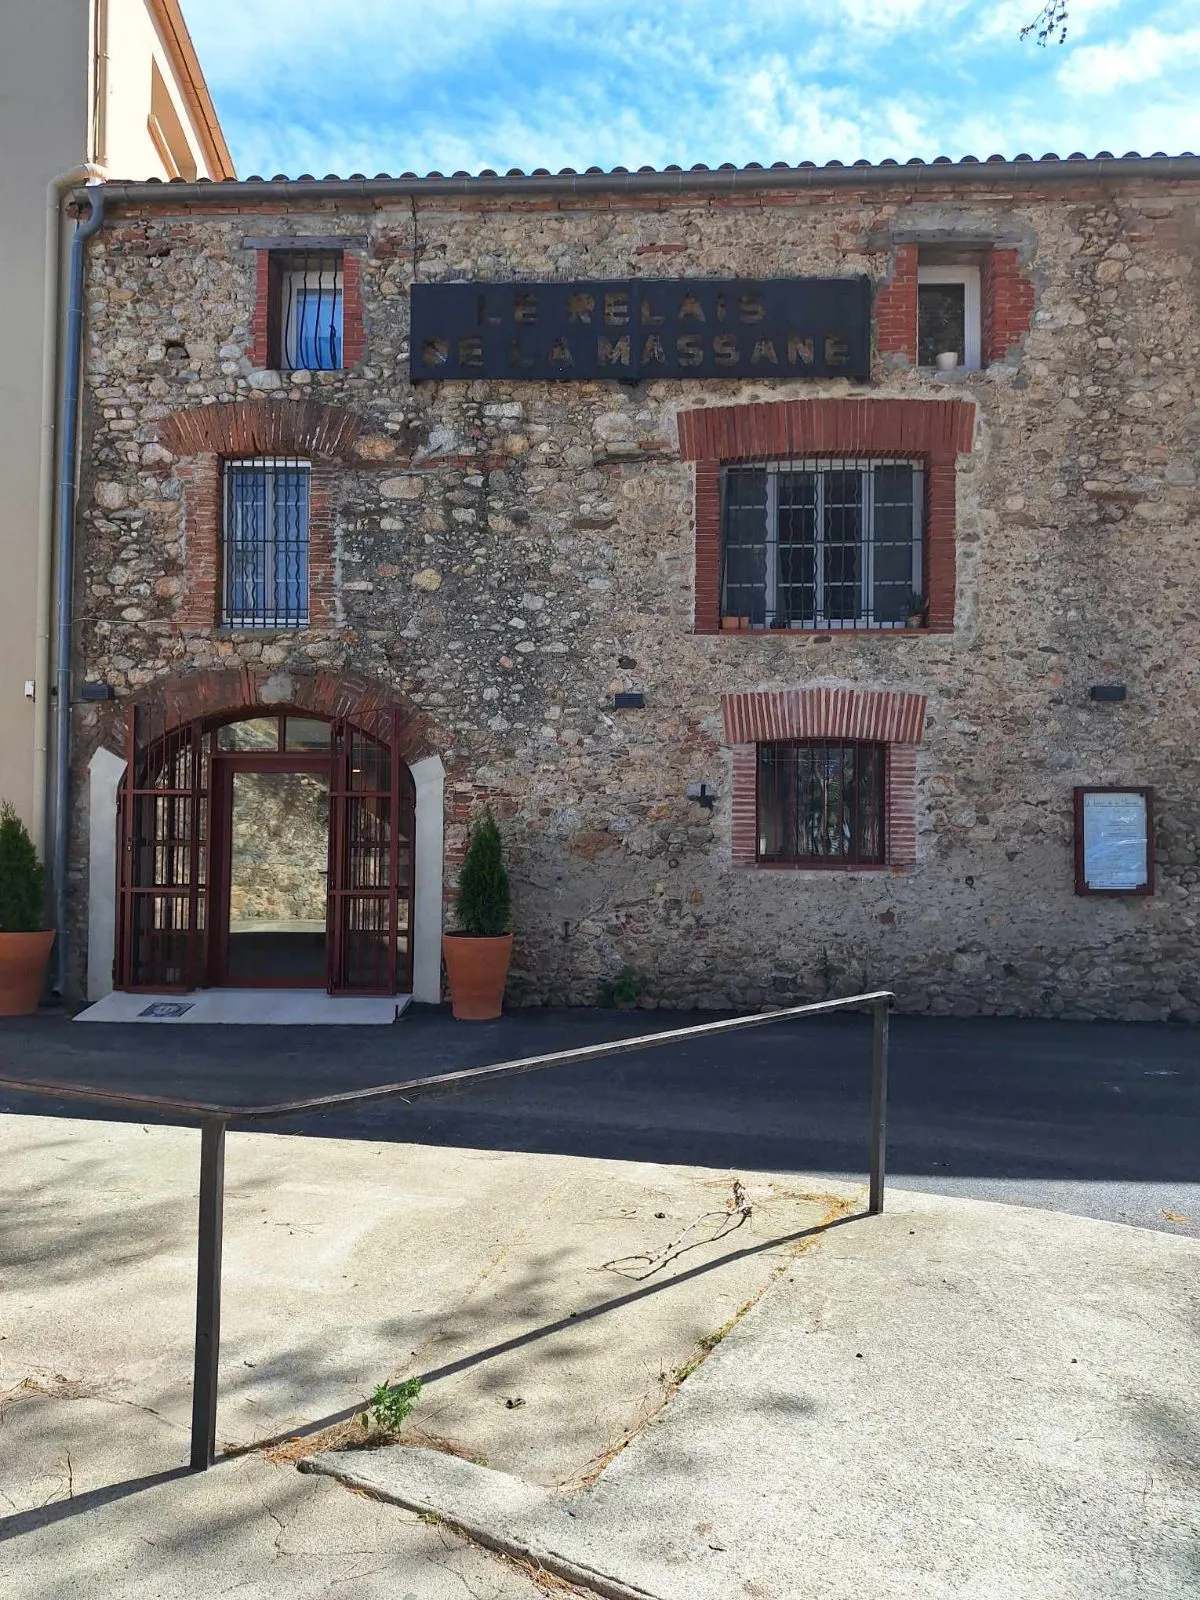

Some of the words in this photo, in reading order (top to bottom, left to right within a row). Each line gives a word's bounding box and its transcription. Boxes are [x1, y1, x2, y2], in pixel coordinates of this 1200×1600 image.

[477, 292, 539, 326] LE
[567, 290, 767, 326] RELAIS
[422, 335, 485, 368] DE
[509, 335, 576, 368] LA
[597, 334, 850, 367] MASSANE
